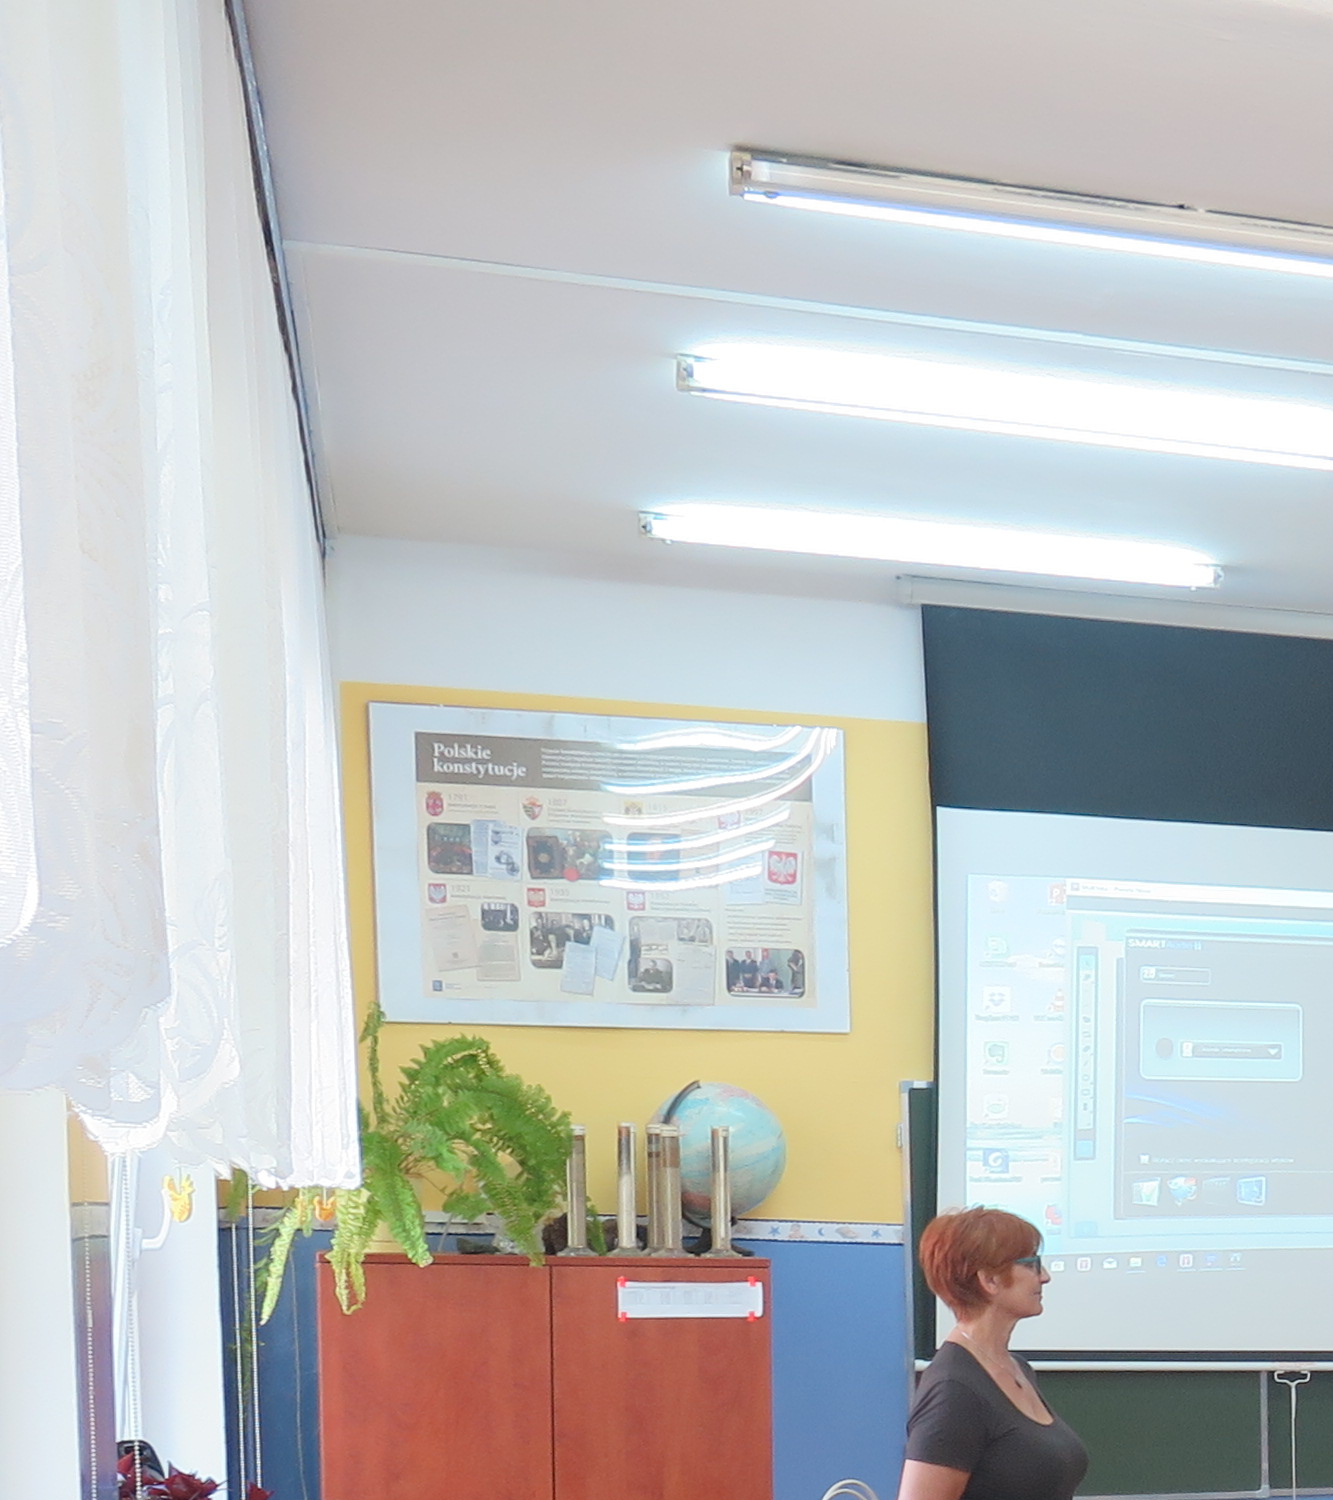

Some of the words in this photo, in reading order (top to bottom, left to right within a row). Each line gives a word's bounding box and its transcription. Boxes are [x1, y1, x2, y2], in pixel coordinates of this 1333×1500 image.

[432, 742, 492, 760] Polskie
[433, 758, 527, 780] konstytucje
[1128, 938, 1167, 949] SMART
